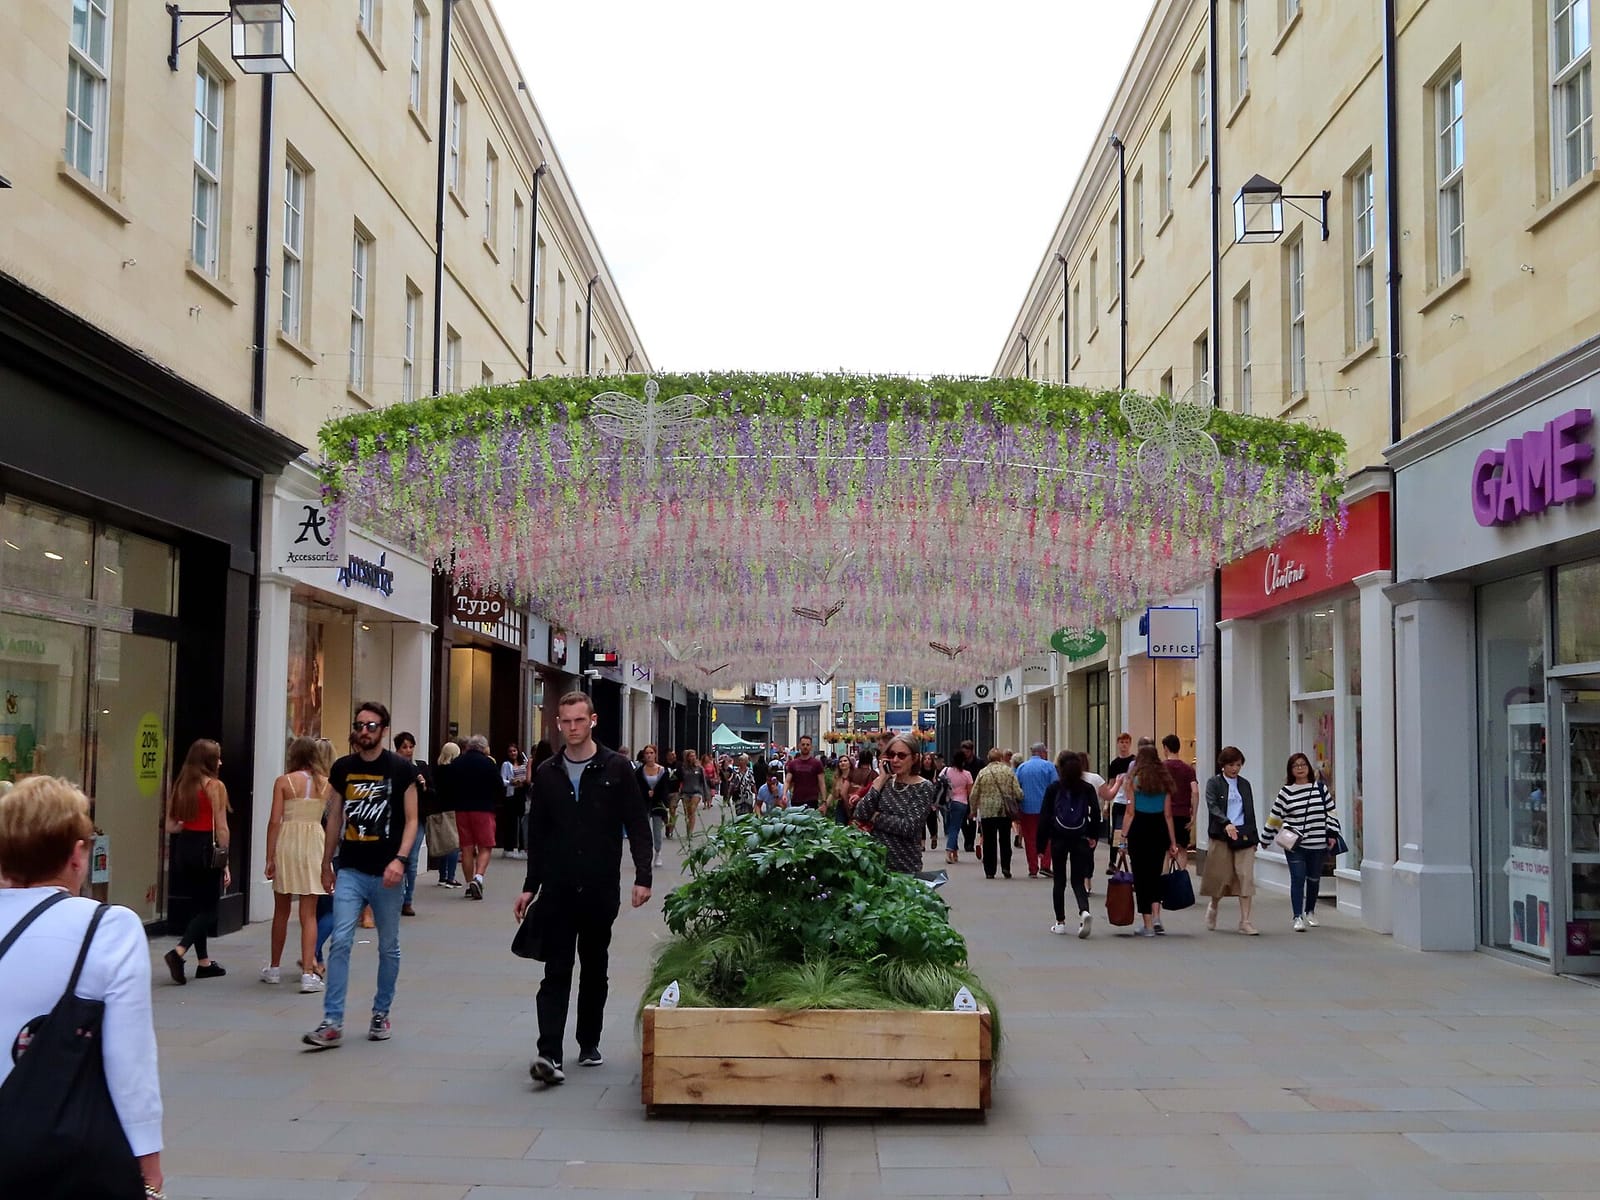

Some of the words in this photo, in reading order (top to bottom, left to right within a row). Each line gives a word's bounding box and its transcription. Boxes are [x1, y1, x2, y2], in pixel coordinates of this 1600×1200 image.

[1471, 408, 1594, 527] GAME
[457, 596, 501, 615] Typo
[1152, 644, 1195, 653] OFFICE
[142, 731, 158, 748] 20%
[142, 752, 156, 769] OFF
[353, 782, 385, 803] THE
[1511, 860, 1525, 871] TIME
[1525, 862, 1534, 872] TO
